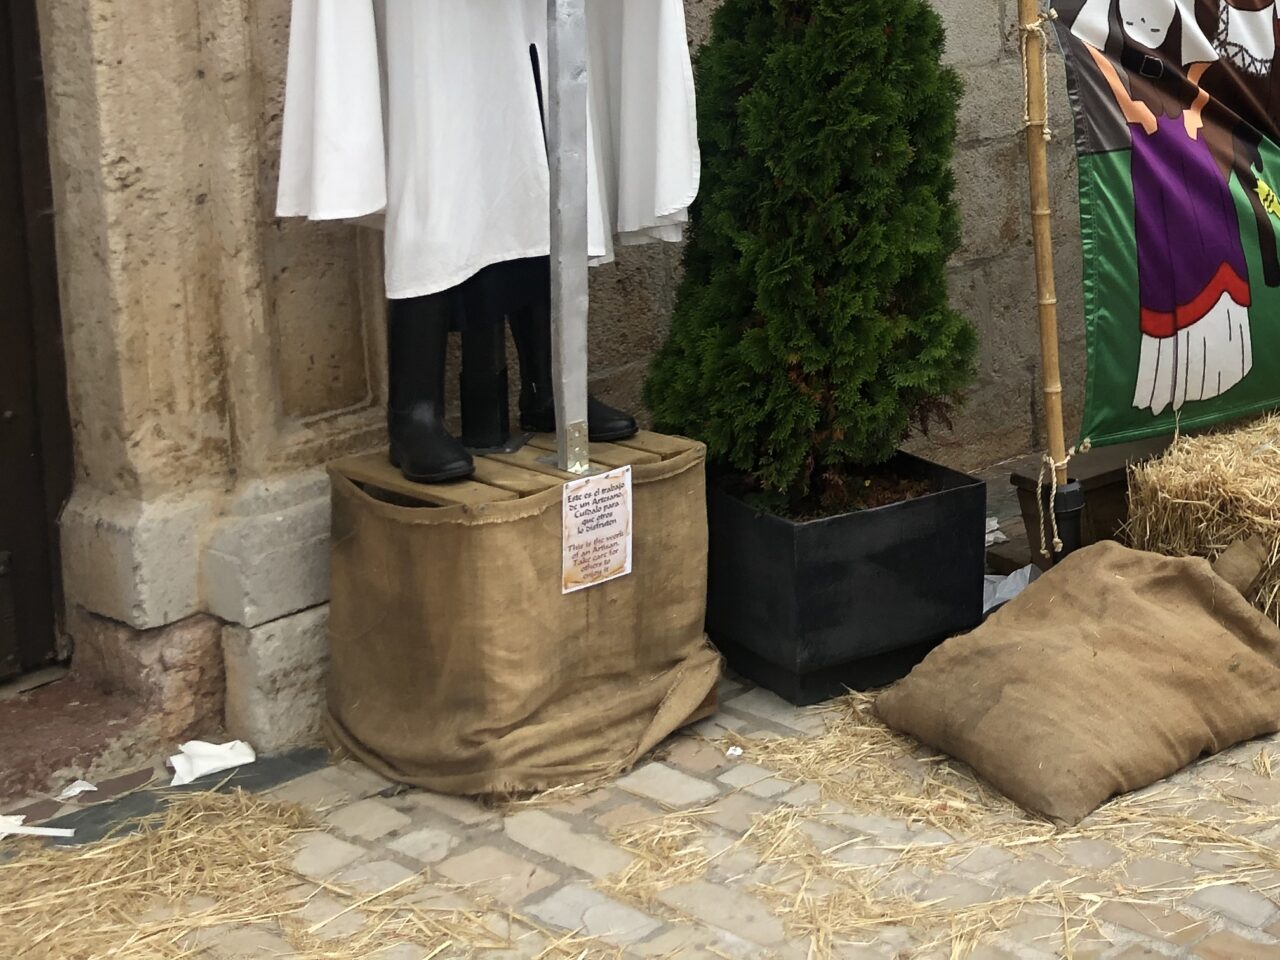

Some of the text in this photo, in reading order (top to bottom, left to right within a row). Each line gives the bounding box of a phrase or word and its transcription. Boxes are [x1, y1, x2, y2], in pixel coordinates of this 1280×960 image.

[594, 488, 600, 497] el
[601, 482, 625, 494] trabajo
[603, 501, 620, 512] para
